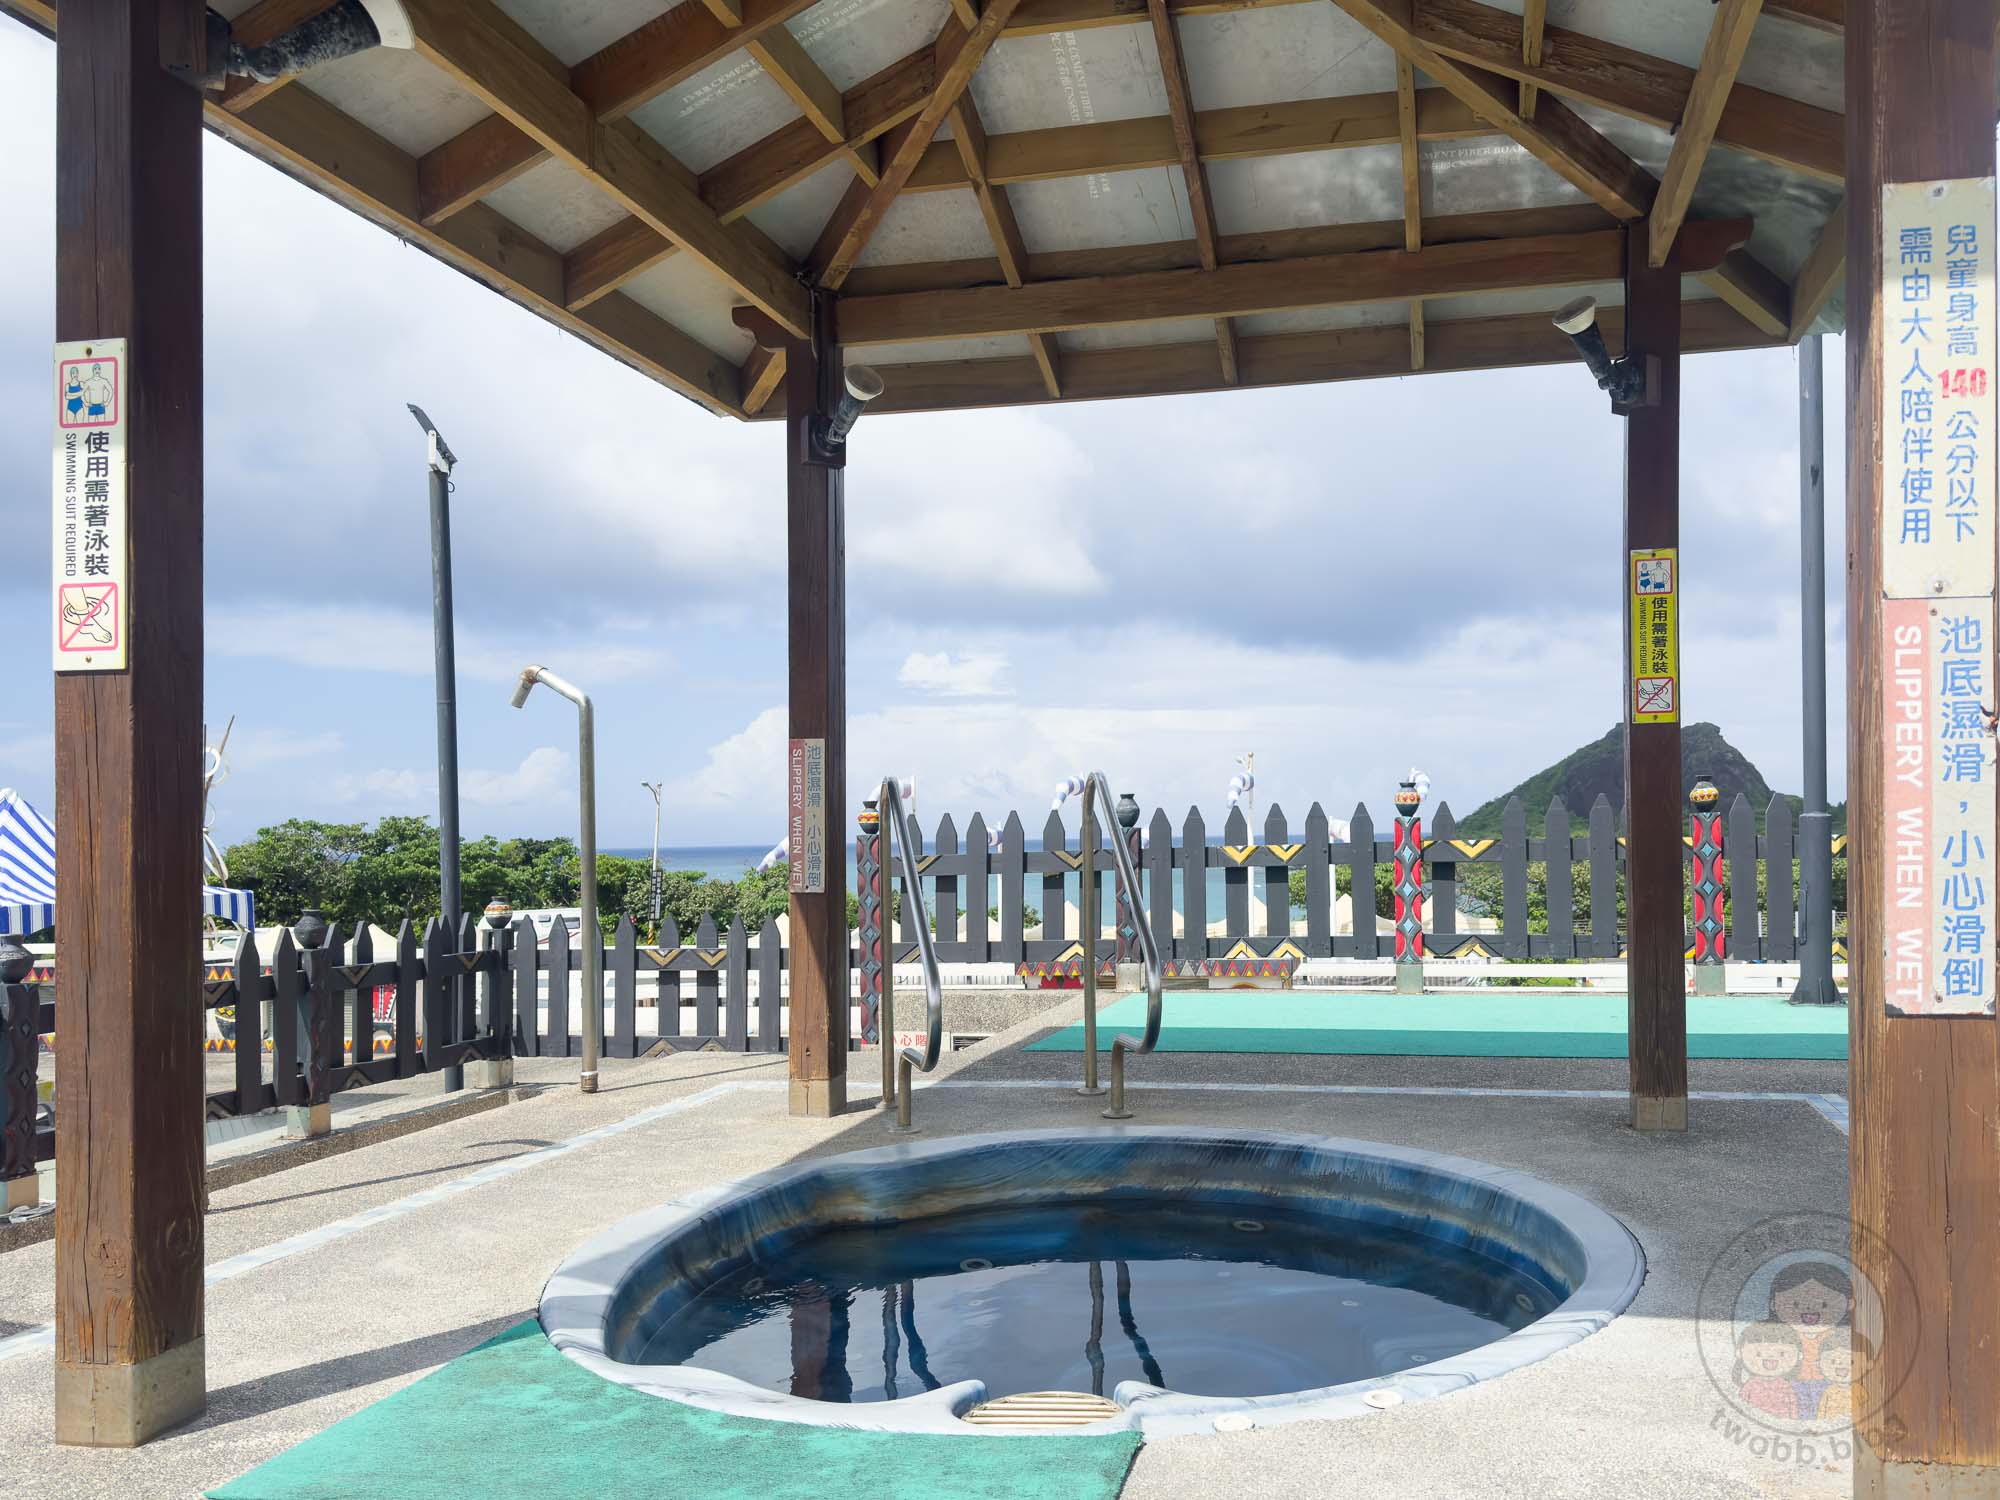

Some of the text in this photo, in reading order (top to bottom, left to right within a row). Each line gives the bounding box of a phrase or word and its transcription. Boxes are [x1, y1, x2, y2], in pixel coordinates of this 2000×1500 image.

[1899, 226, 1932, 545] 需由大人陪伴使用
[65, 433, 77, 577] SWIMMING SUIT REQUIRED
[84, 431, 110, 577] 使用需著泳裝
[1651, 597, 1669, 674] 使用需著泳裝
[792, 748, 802, 888] SLIPPERY WHEN WET
[1893, 625, 1924, 1003] SLIPPERY WHEN WET
